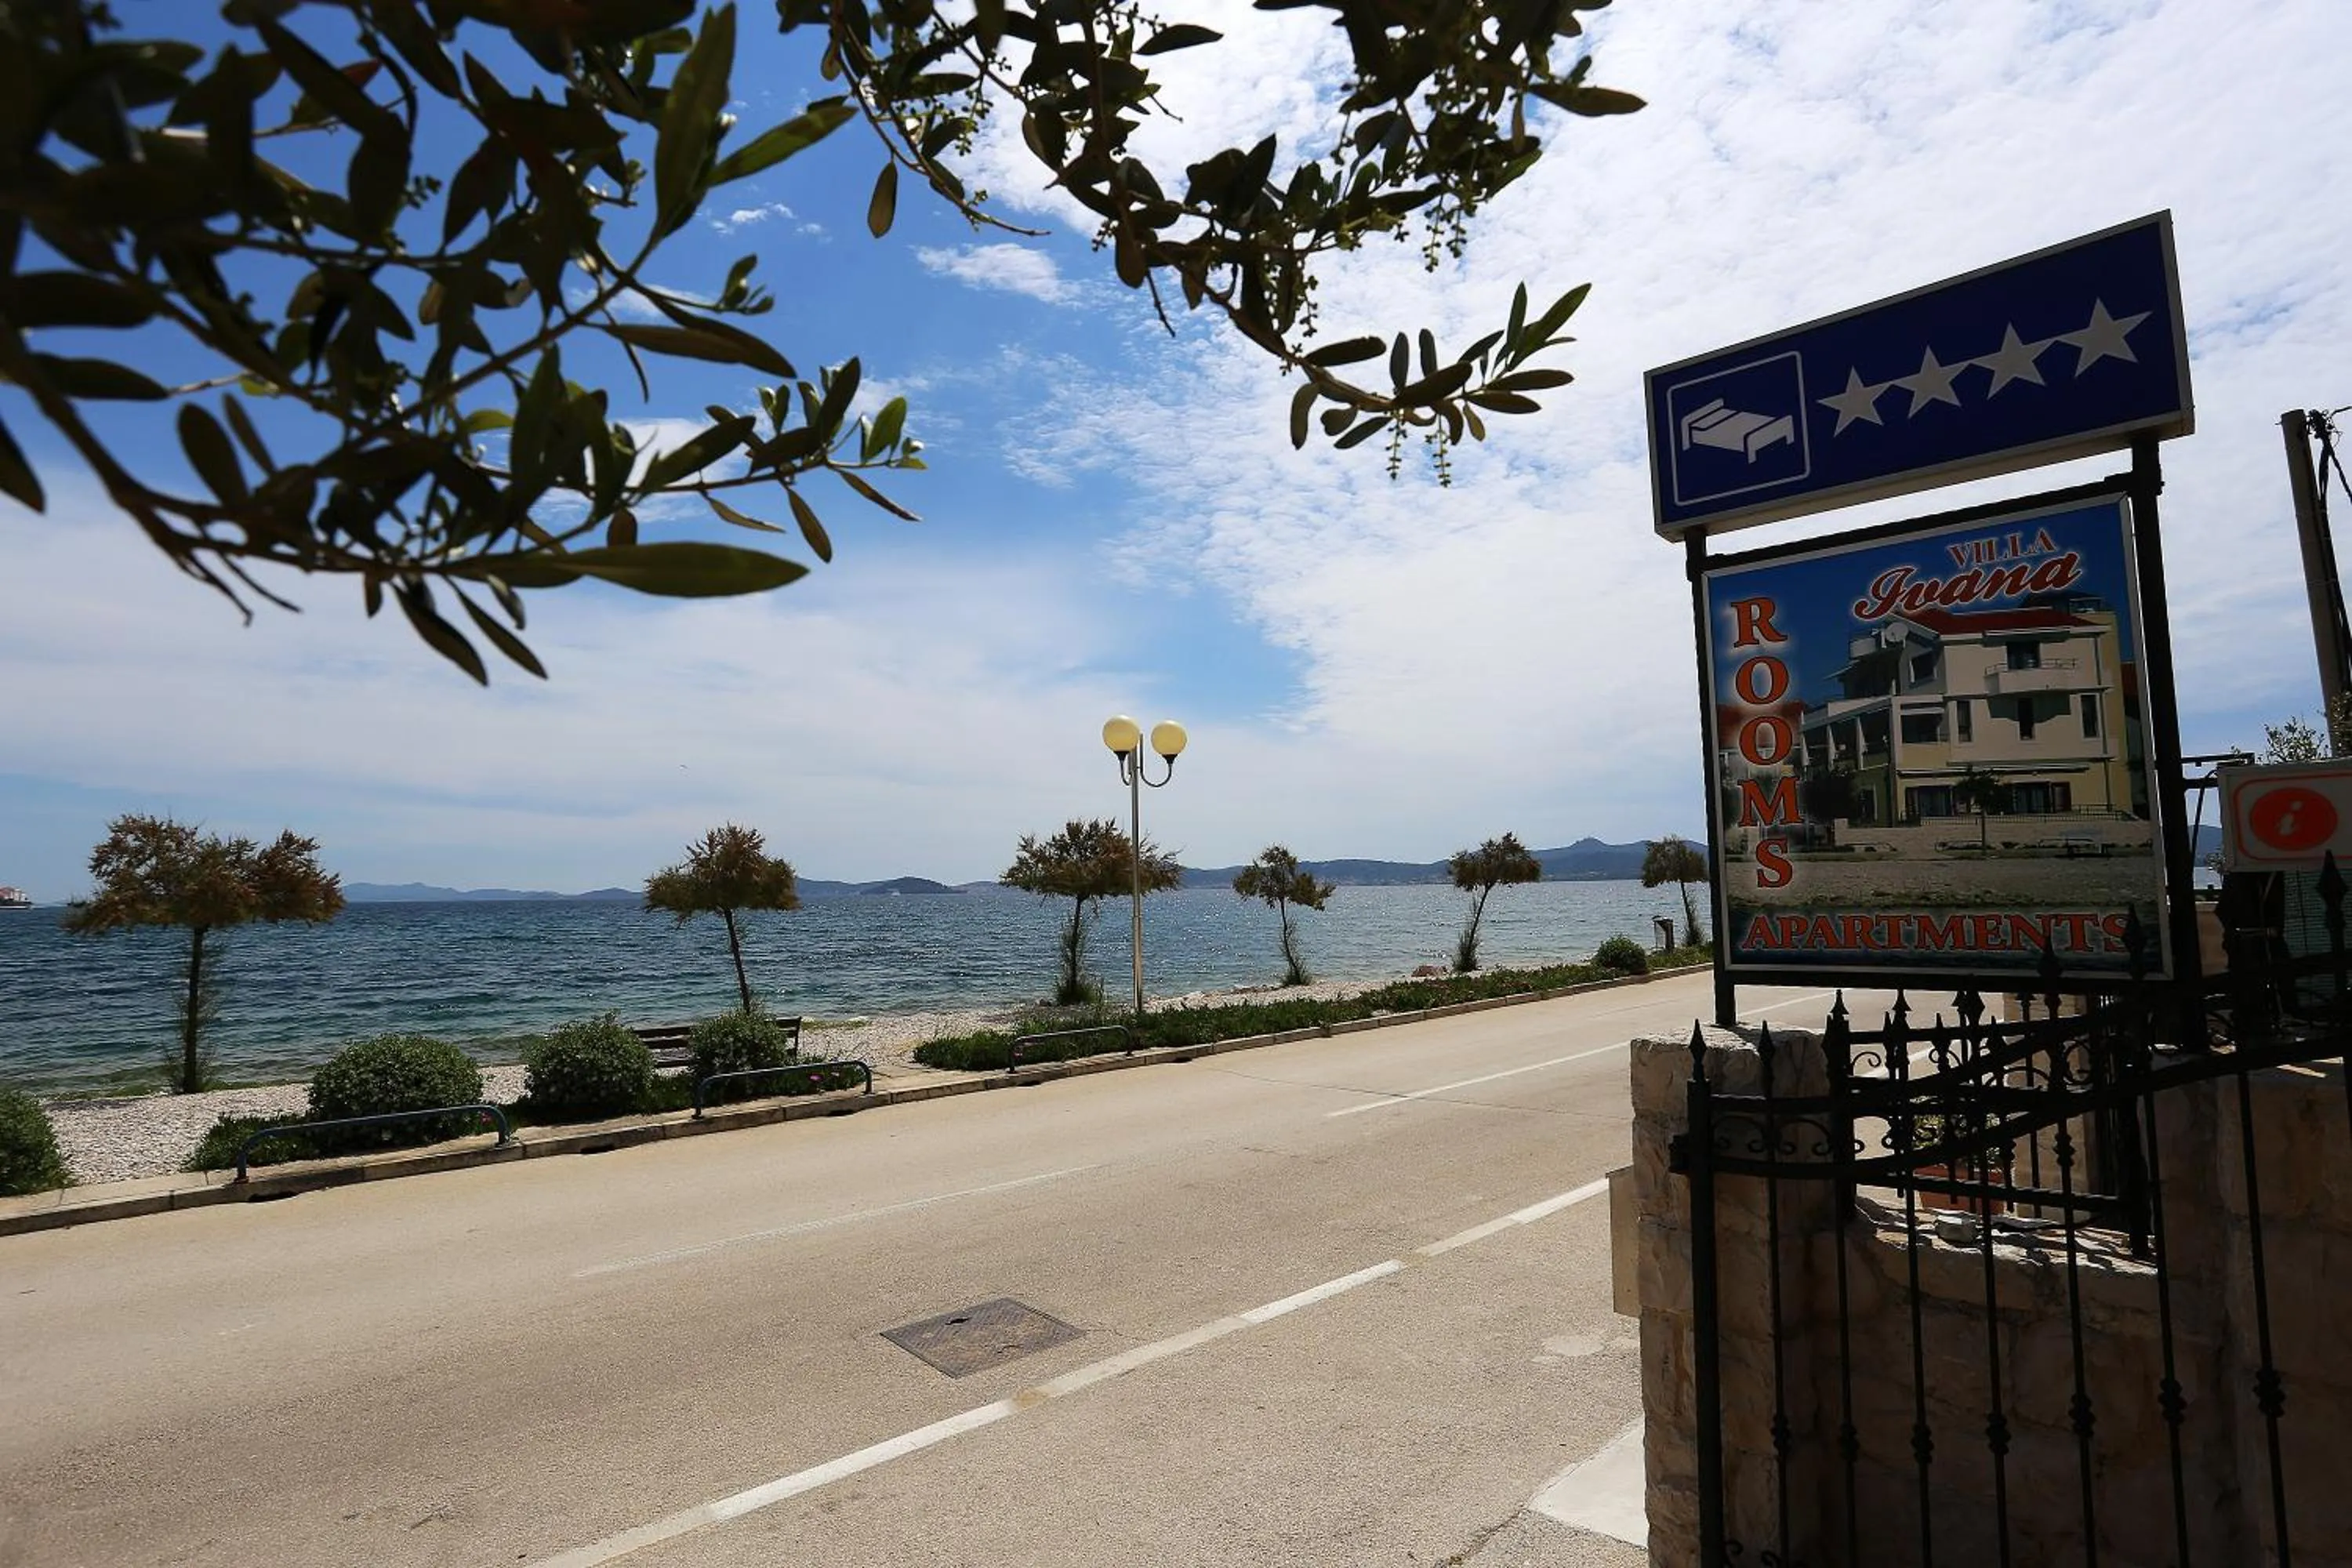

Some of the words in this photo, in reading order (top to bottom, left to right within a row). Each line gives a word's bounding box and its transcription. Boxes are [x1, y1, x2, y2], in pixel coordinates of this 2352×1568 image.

[1948, 528, 2056, 566] VILLA
[1853, 552, 2082, 619] Ivana
[1730, 597, 1802, 888] ROOMS
[1742, 912, 2132, 955] APARTMENTS
